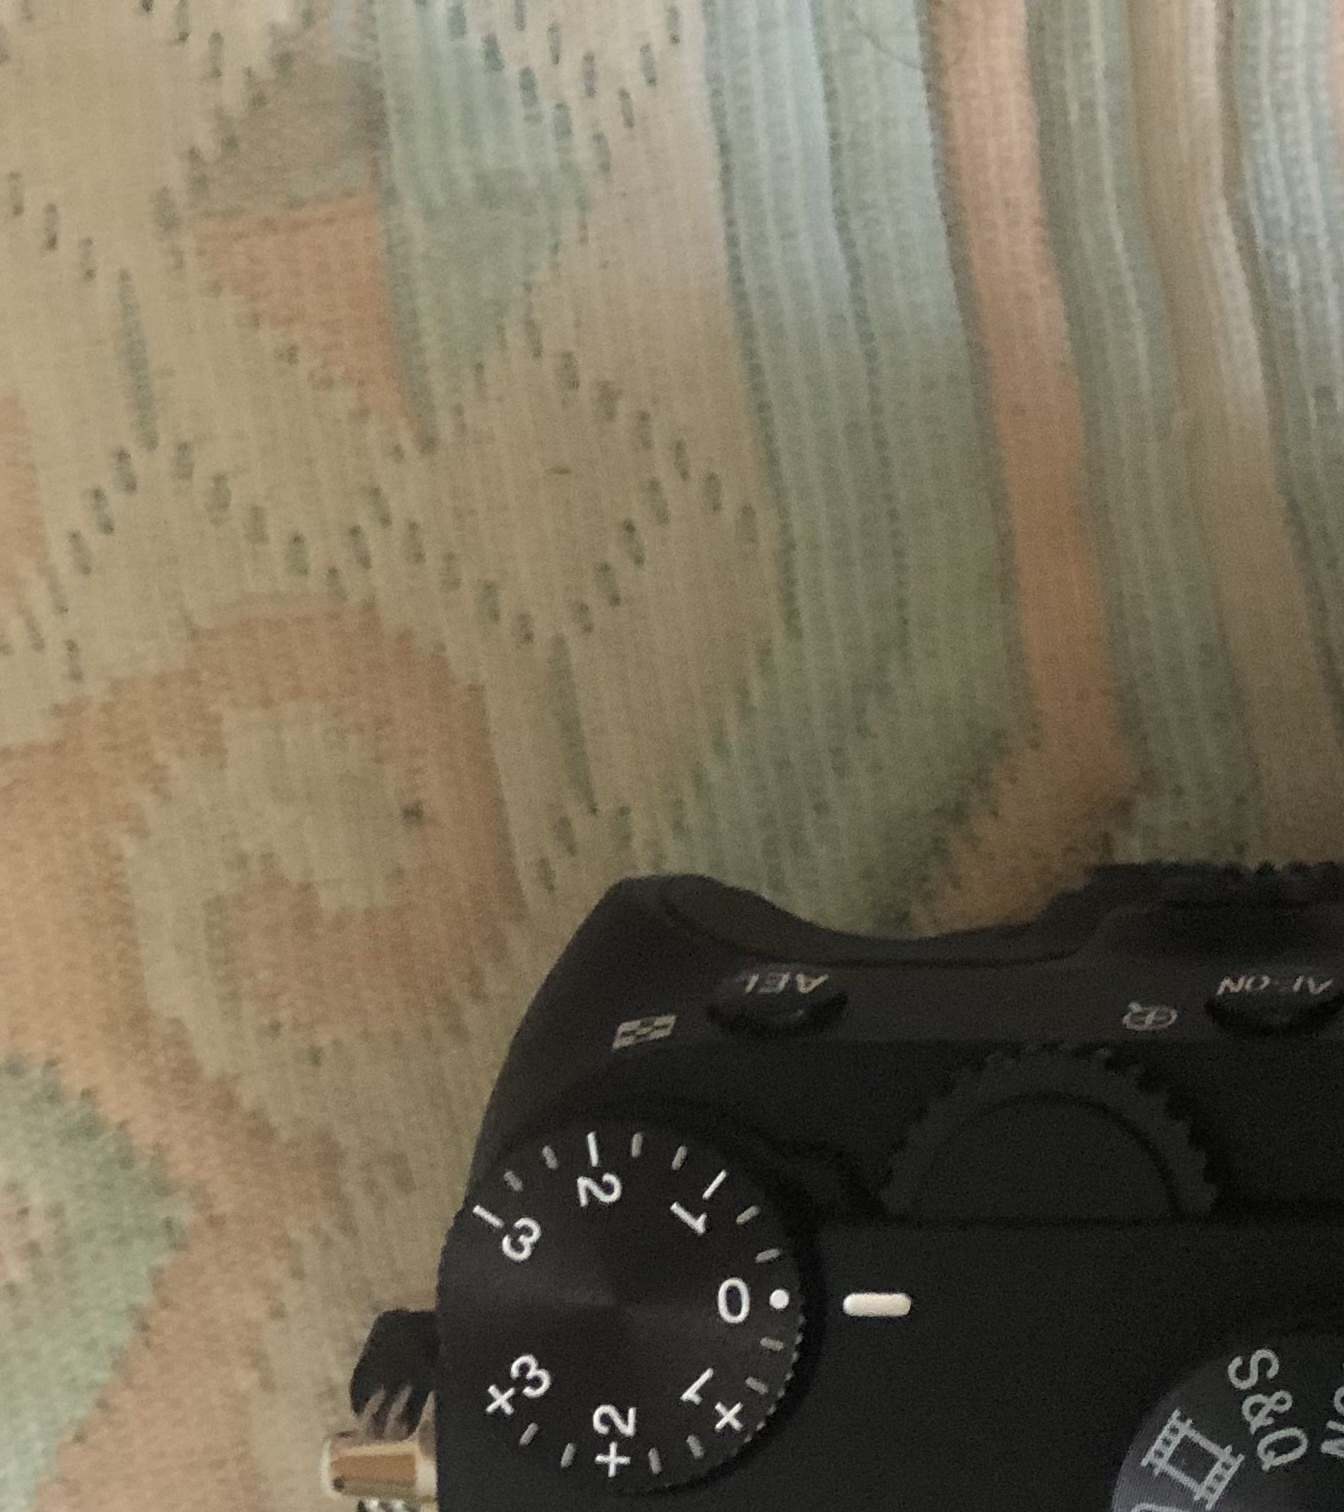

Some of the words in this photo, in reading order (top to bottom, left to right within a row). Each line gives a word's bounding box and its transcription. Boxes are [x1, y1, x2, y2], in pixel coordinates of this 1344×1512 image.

[717, 1277, 750, 1324] 0
[485, 1354, 551, 1415] +3
[1227, 1348, 1309, 1471] S&Q
[592, 1404, 636, 1478] +2
